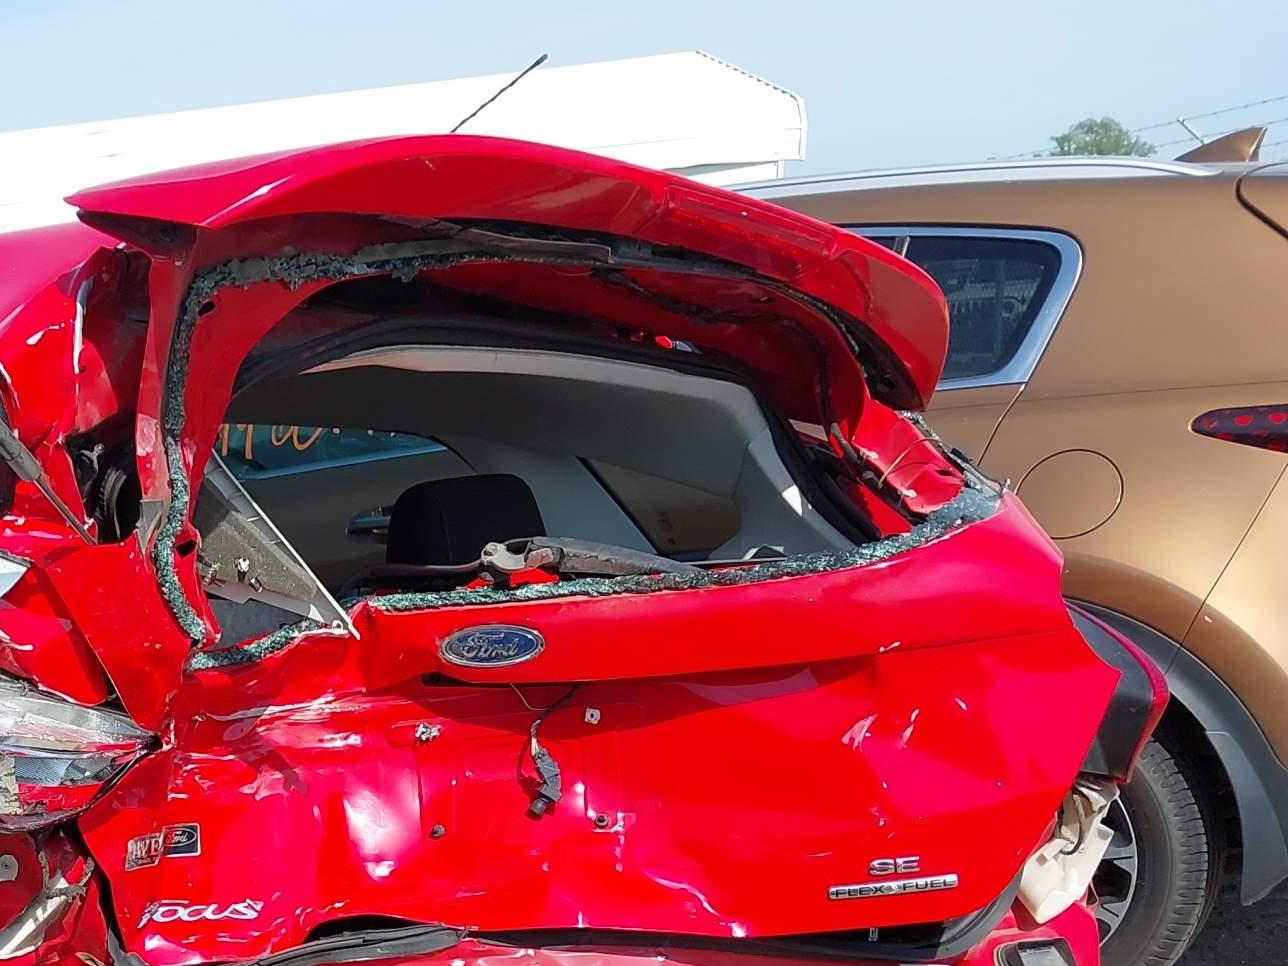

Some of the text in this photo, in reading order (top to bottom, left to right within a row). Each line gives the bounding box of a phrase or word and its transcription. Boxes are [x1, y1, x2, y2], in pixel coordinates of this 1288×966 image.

[461, 632, 520, 657] Ford
[165, 830, 188, 843] Ford
[869, 856, 920, 875] SE
[834, 878, 956, 898] FLEX FUEL
